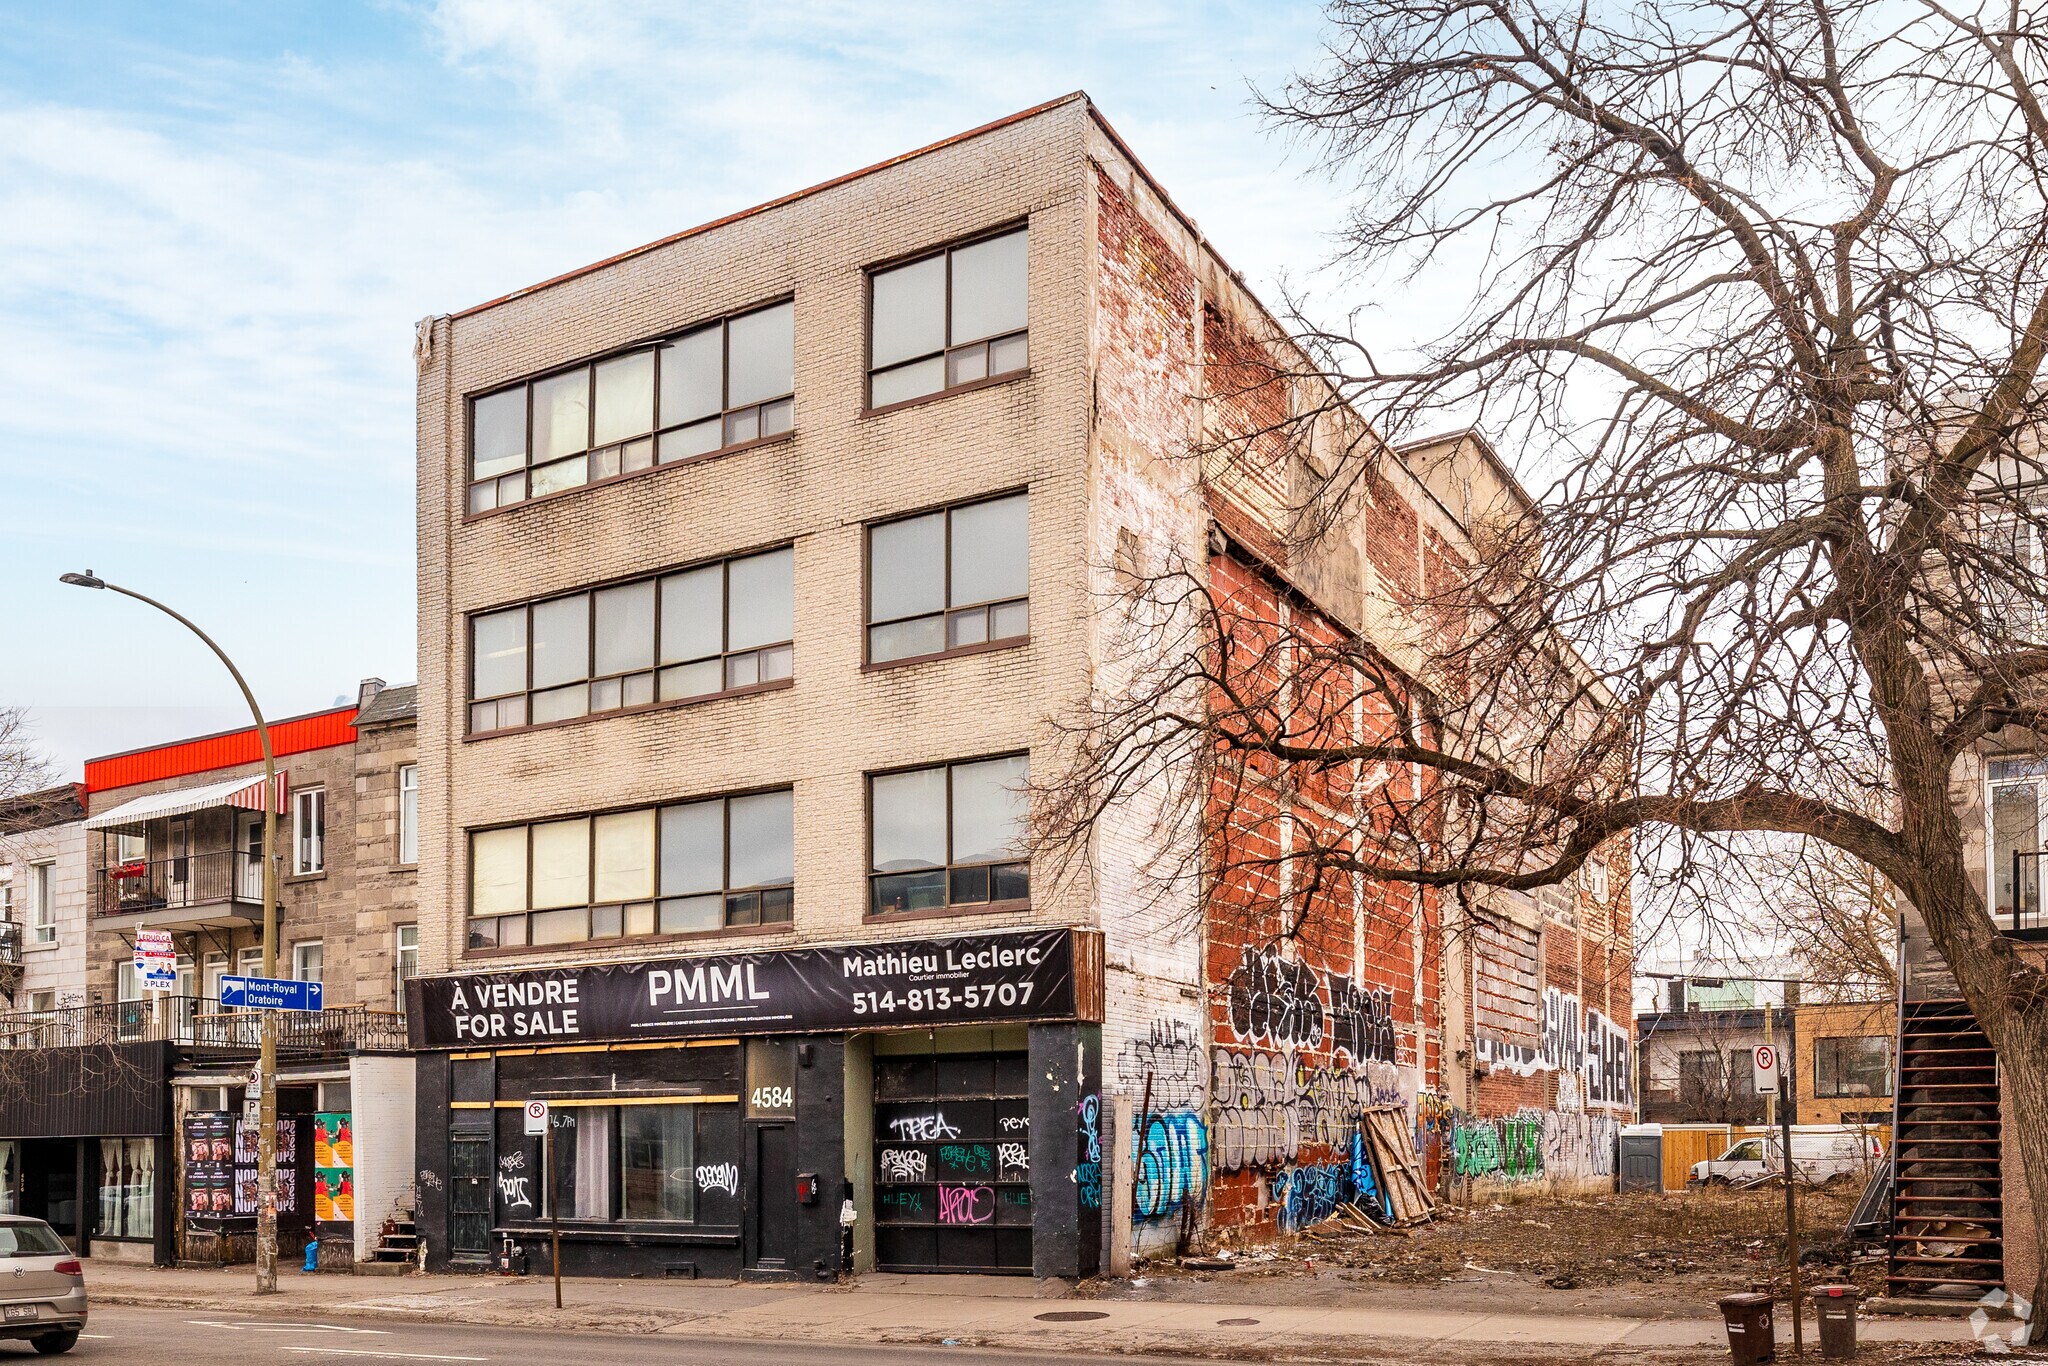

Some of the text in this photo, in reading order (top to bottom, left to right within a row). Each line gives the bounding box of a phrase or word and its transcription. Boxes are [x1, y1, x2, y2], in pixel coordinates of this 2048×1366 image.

[843, 945, 1041, 978] Mathieu Leclerc
[150, 980, 171, 988] PLEX
[248, 981, 297, 996] Mont-Royal
[648, 963, 770, 1007] PMML
[908, 971, 970, 982] Courtier immobilier
[248, 993, 284, 1006] Oratoire
[451, 979, 580, 1010] À VENDRE
[853, 982, 1035, 1015] 514-813-5707
[455, 1009, 580, 1039] FOR SALE
[751, 1086, 793, 1109] 4584
